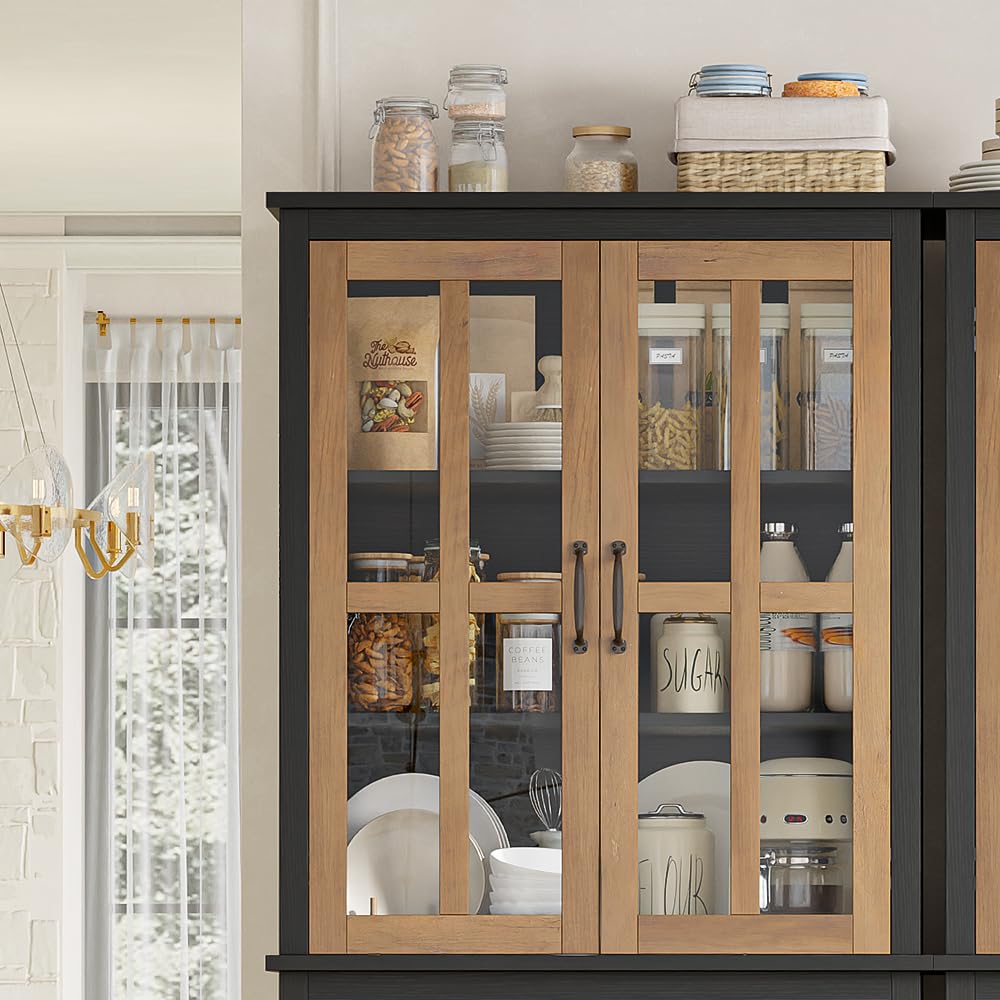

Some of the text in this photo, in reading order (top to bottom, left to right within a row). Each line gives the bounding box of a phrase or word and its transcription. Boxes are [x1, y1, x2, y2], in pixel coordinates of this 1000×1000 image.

[370, 339, 388, 353] The
[363, 351, 417, 369] Nuthouse
[660, 645, 724, 695] SUGAR
